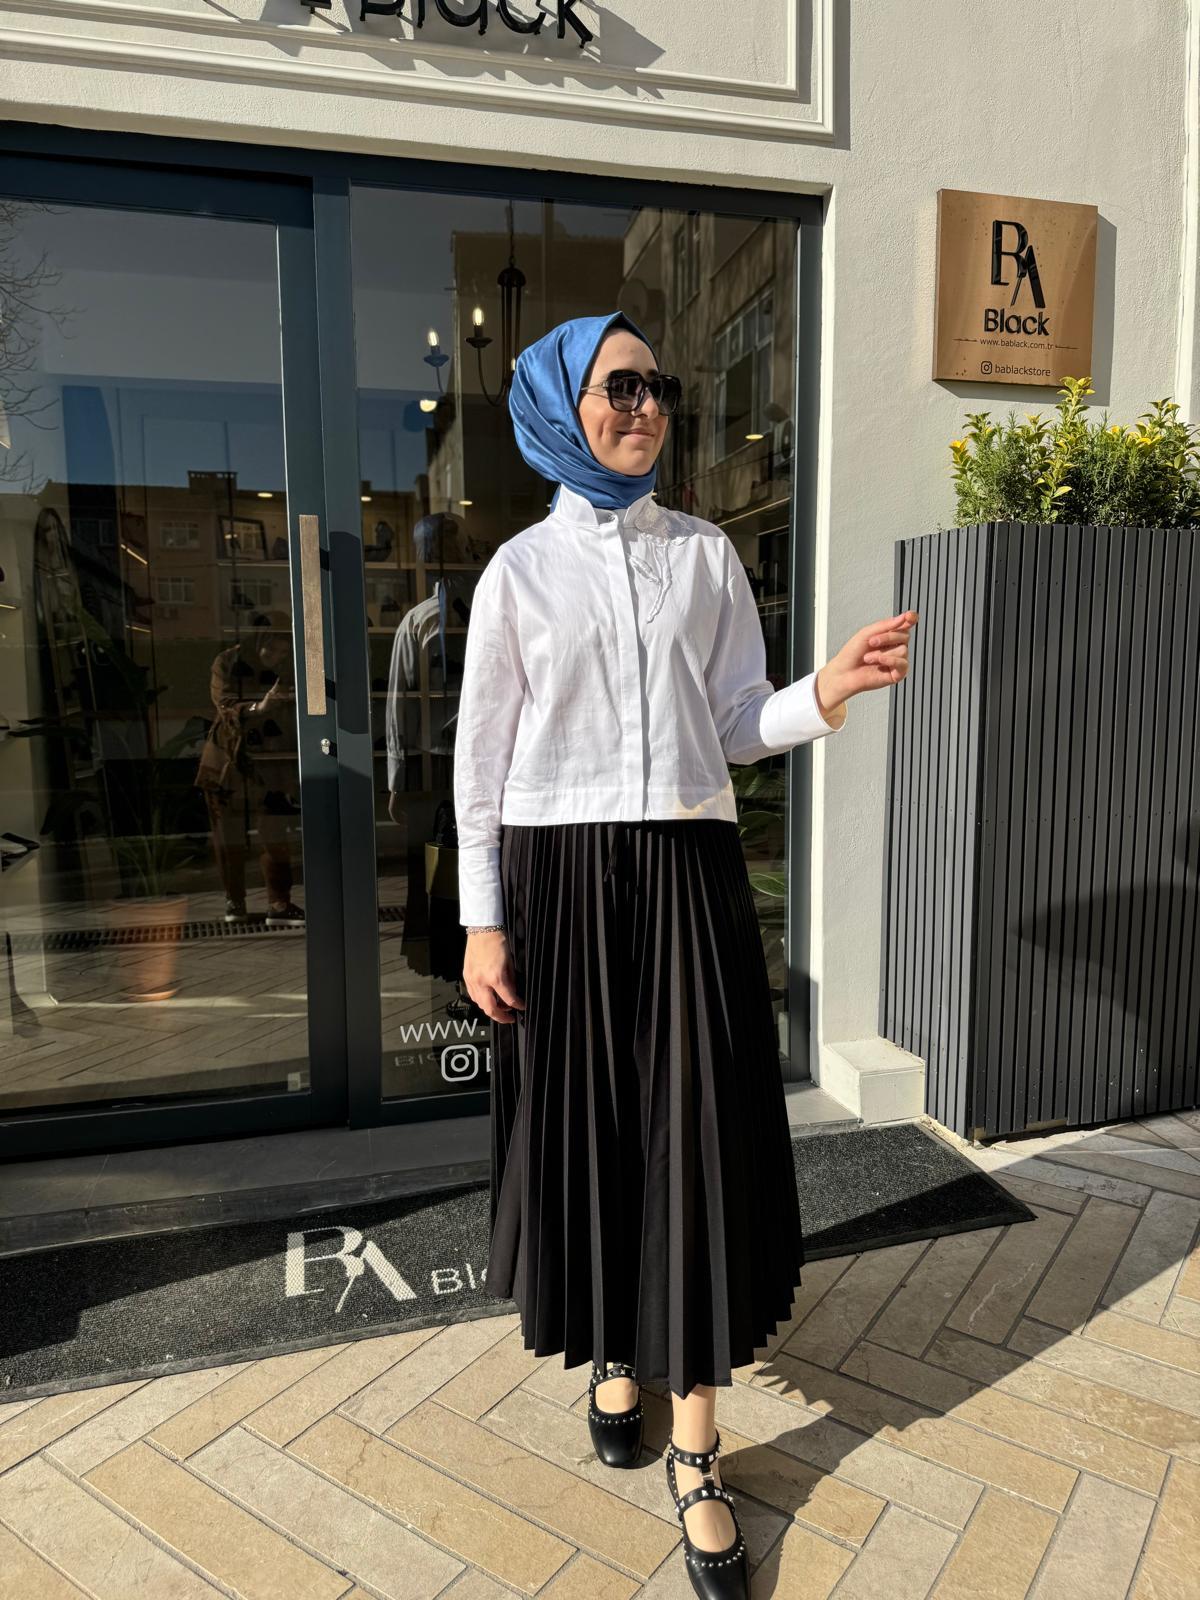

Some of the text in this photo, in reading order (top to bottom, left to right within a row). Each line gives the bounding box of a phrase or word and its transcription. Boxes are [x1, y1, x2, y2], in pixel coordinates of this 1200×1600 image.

[984, 308, 1050, 336] Black
[980, 338, 1053, 350] www.bablack.com.tr
[995, 364, 1051, 377] bablackstore
